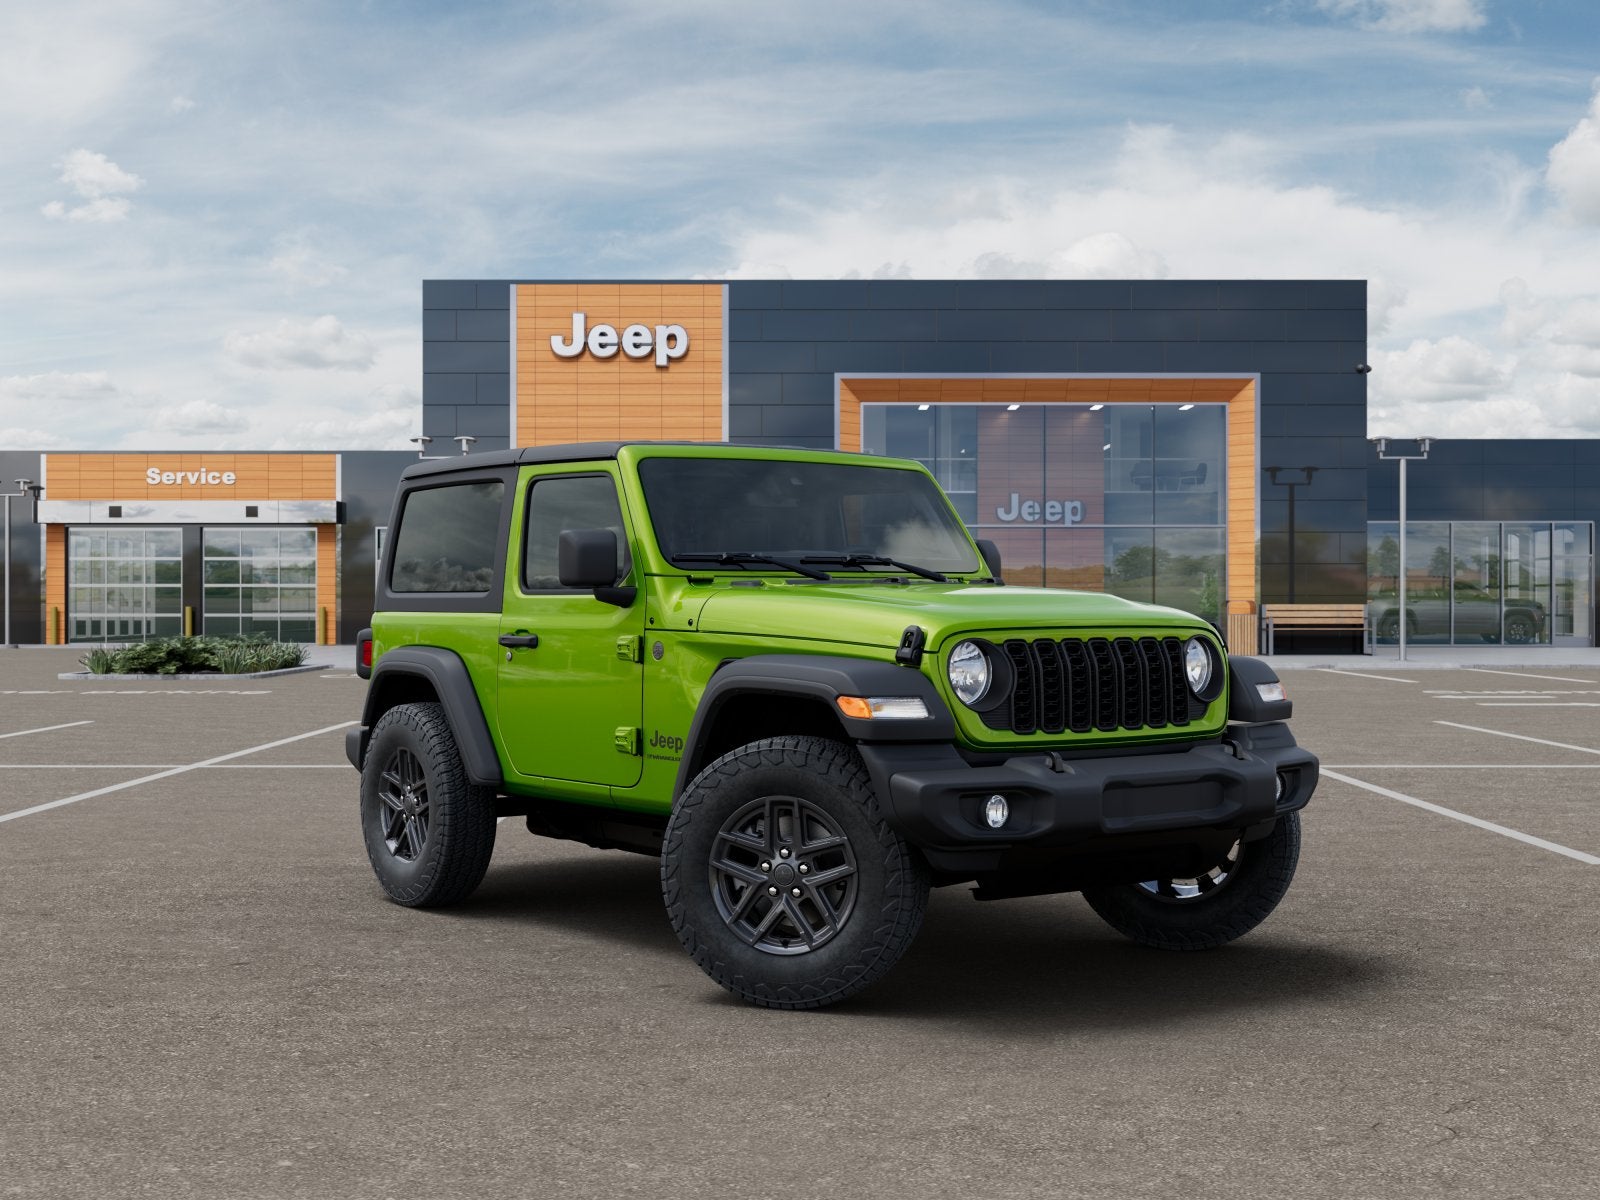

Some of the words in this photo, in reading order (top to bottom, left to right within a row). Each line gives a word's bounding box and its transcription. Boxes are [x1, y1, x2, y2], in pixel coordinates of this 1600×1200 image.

[550, 312, 690, 367] Jeep
[146, 467, 237, 485] Service
[996, 493, 1083, 527] Jeep
[649, 730, 684, 753] Jeep
